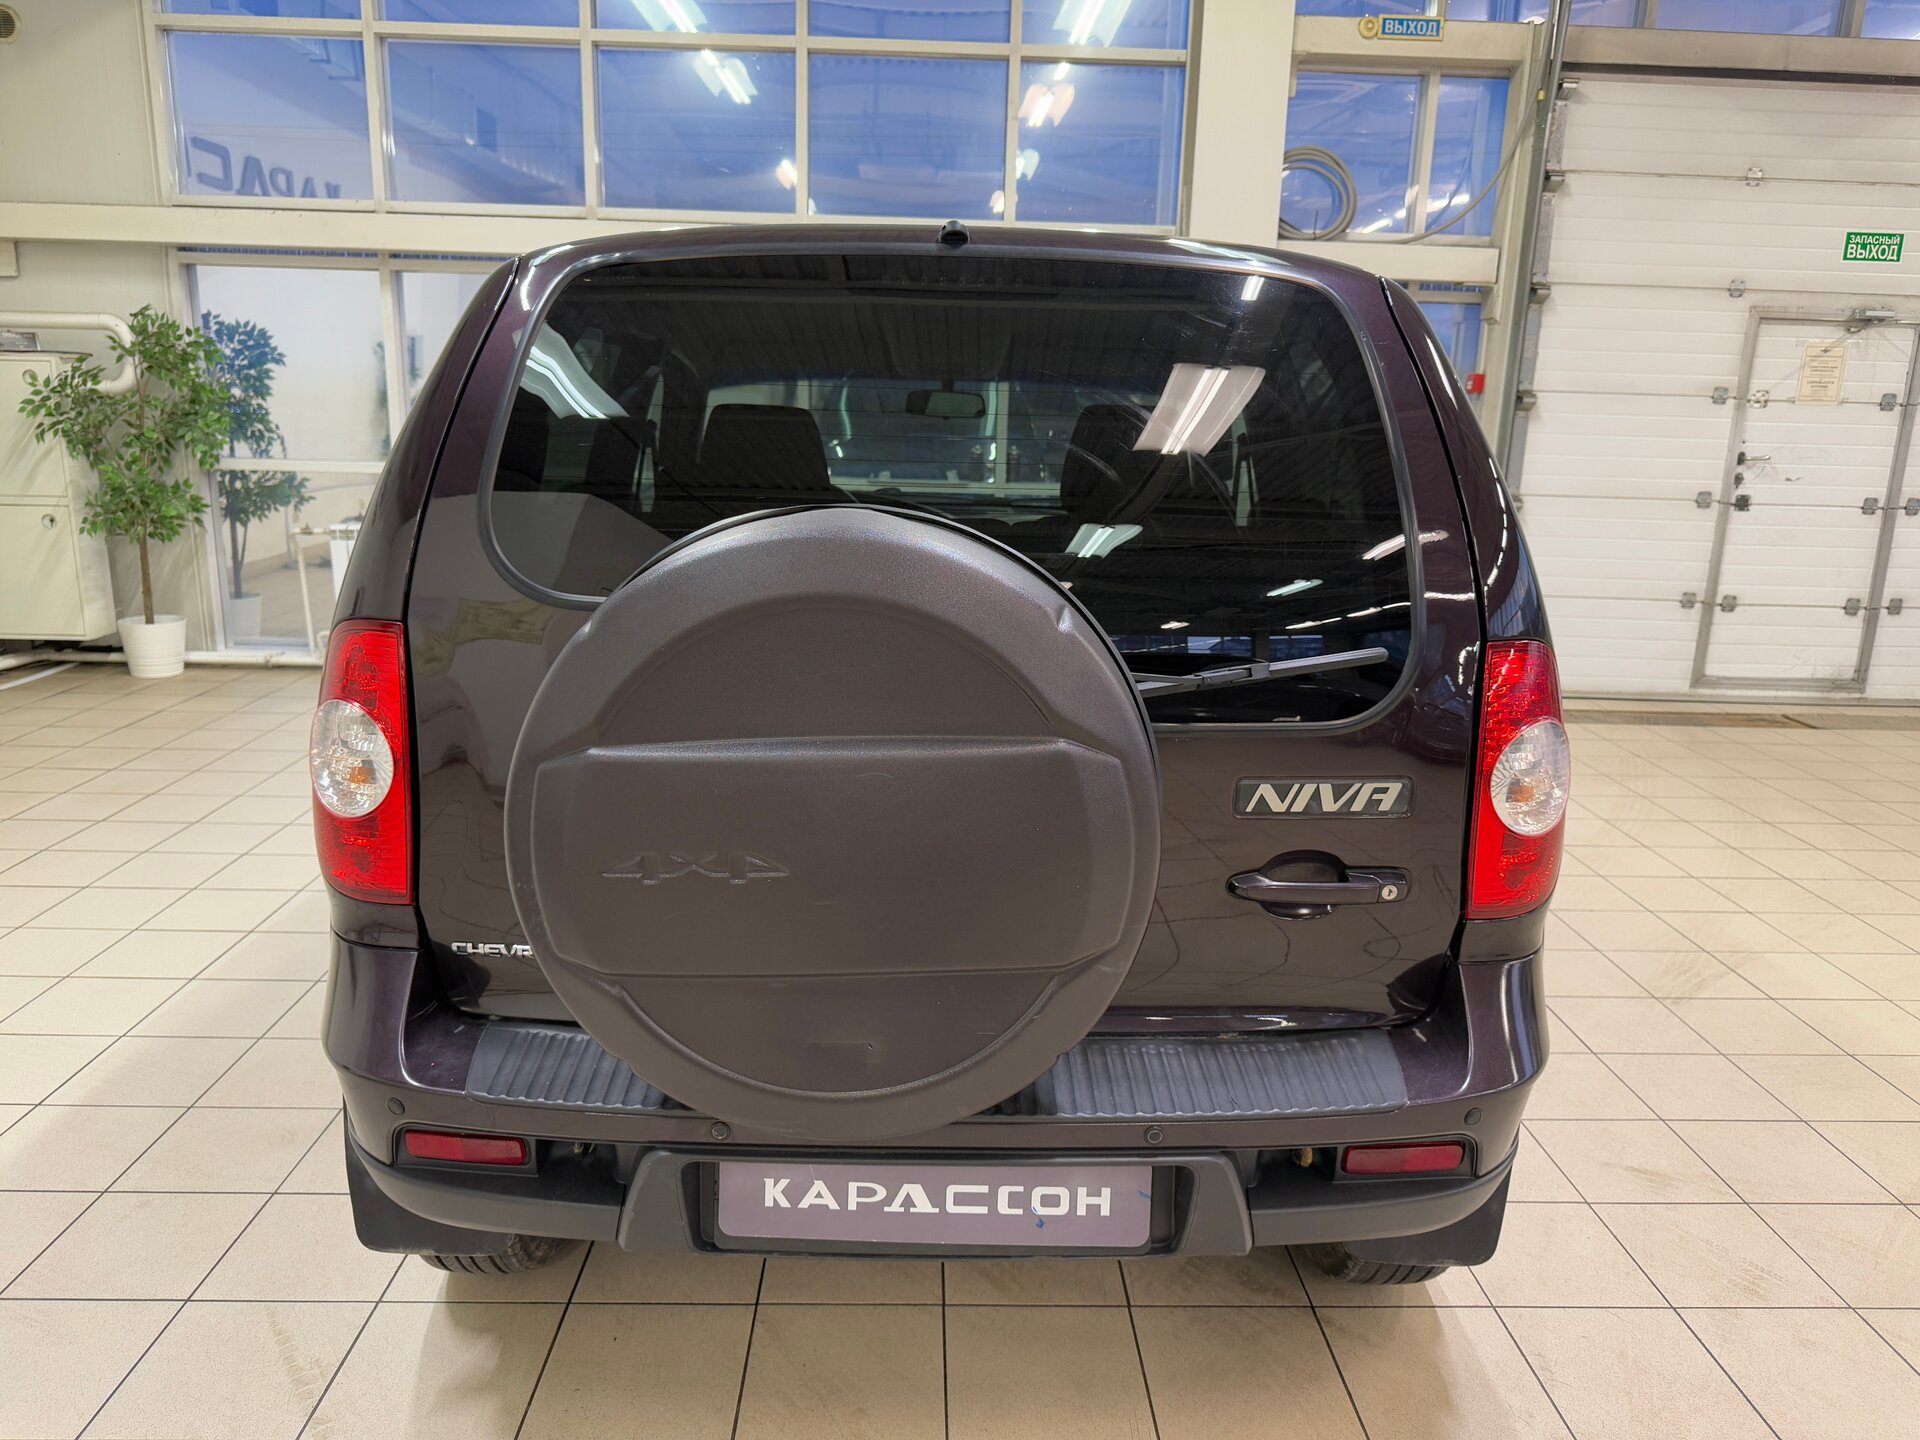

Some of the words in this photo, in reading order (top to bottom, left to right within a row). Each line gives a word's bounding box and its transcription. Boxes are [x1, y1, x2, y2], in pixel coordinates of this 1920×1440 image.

[1385, 19, 1437, 36] ВЫХОД
[1849, 234, 1901, 245] ЗАПАСНЫЙ
[1846, 244, 1899, 261] ВЫХОД
[1245, 783, 1403, 813] NIVA
[764, 1178, 1110, 1217] КАРАССОН
